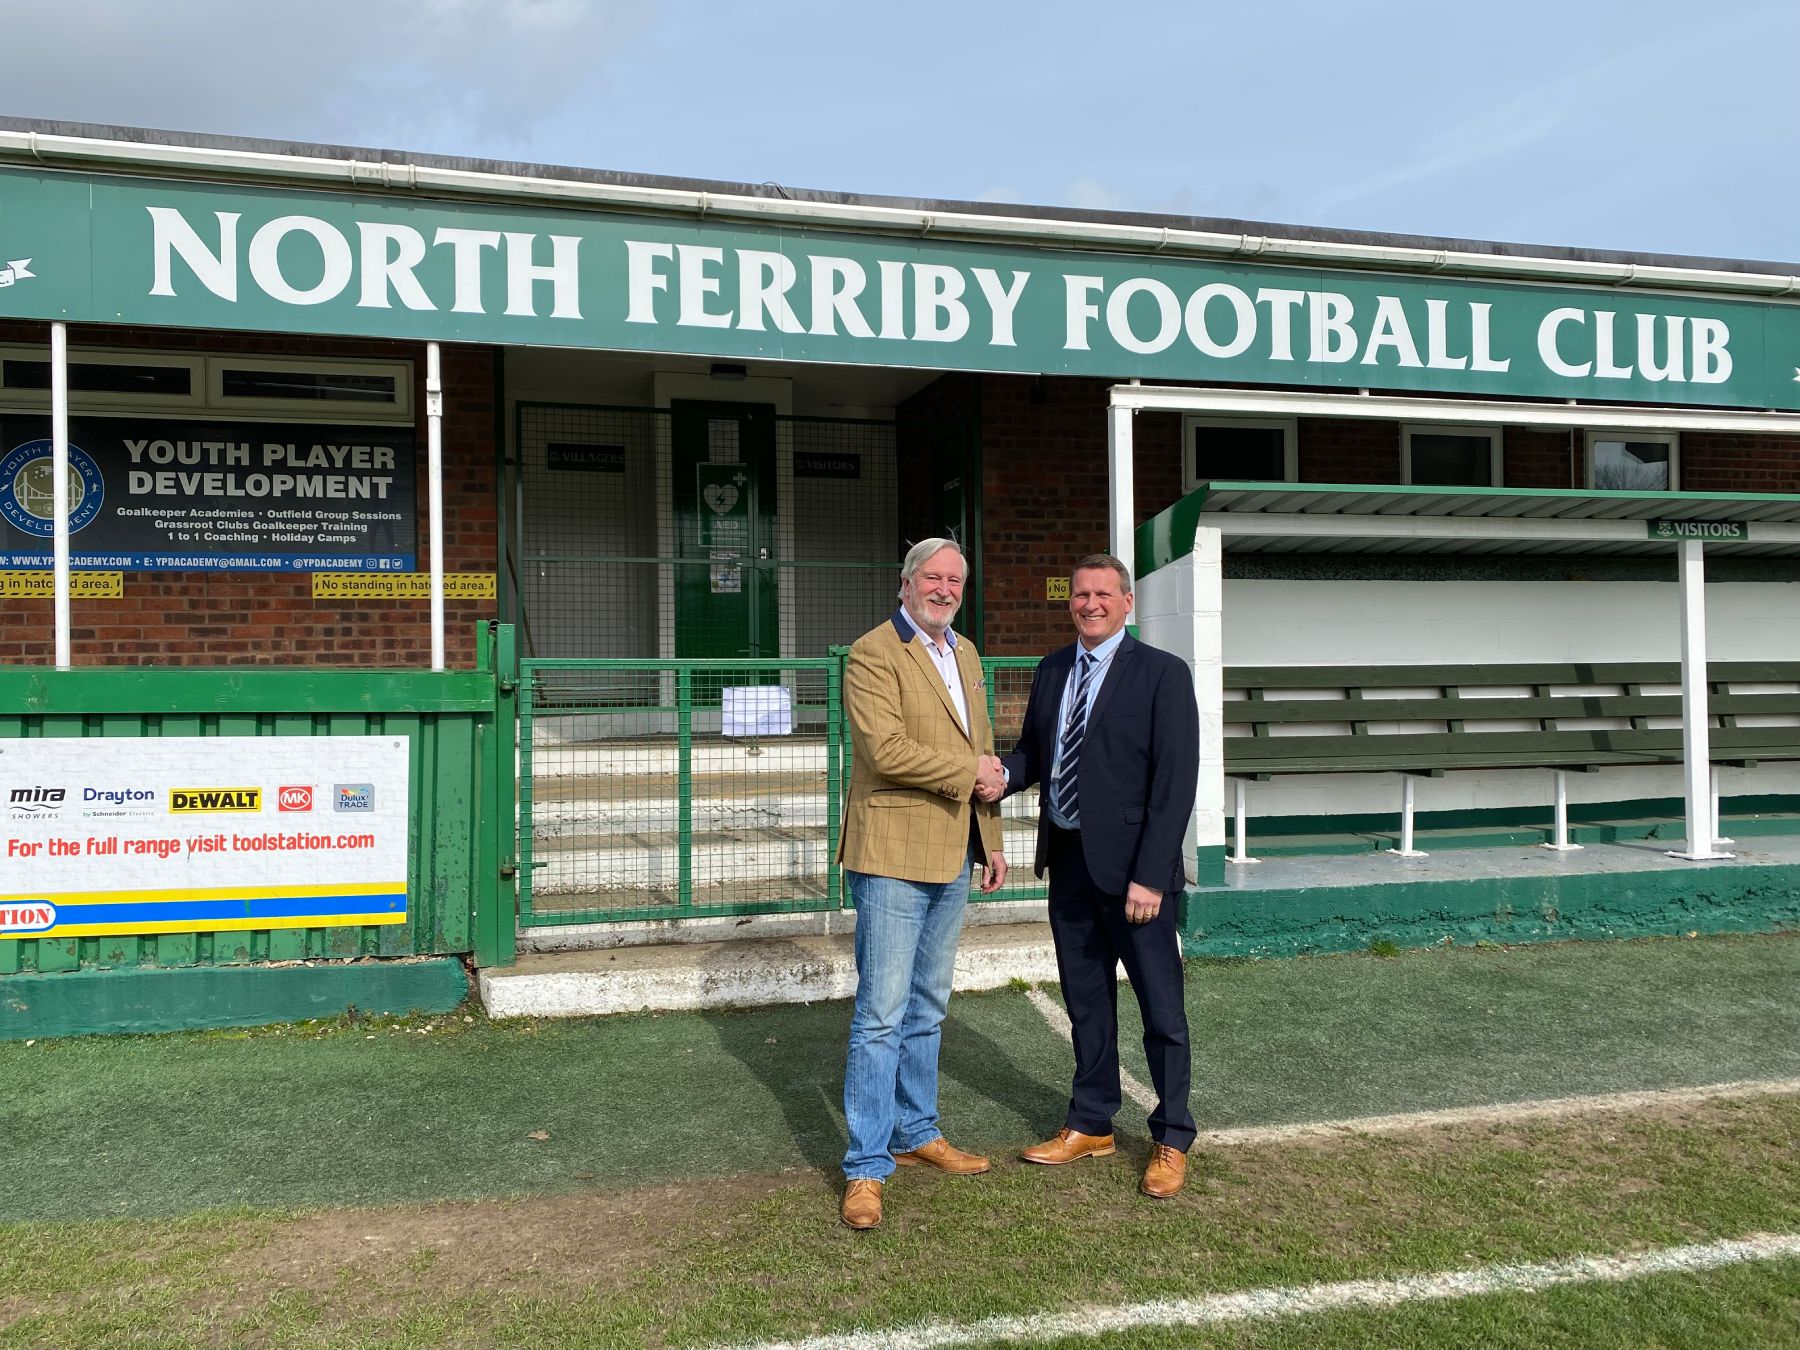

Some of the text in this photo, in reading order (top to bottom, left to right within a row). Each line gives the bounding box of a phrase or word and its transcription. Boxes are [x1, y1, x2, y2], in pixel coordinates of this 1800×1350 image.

[145, 206, 1733, 384] NORTH FERRIBY FOOTBALL CLUB
[4, 446, 41, 476] YOUTH
[123, 440, 396, 470] YOUTH PLAYER
[562, 451, 625, 463] VILLAGERS
[807, 459, 855, 471] VISITORS
[128, 470, 393, 499] DEVELOPMENT
[116, 507, 402, 521] Goalkeeper Academies Outfield Group Sessions
[154, 520, 368, 533] Grassroot Clubs Goalkeeper Training
[1674, 522, 1741, 537] VISITORS
[168, 532, 357, 544] 1 to 1 Coaching Holiday Camps
[12, 556, 132, 566] WWW.YPCADEMY.COM
[143, 557, 153, 566] E:
[156, 557, 282, 568] YPDACADEMY@GMAIL.COM
[292, 558, 363, 568] @YPDACADEMY
[9, 578, 21, 589] in
[25, 578, 78, 589] hatcd
[81, 579, 113, 589] area.
[322, 580, 339, 590] No
[342, 580, 393, 592] standing
[397, 580, 407, 590] in
[460, 582, 488, 591] area.
[1054, 583, 1067, 593] No
[10, 786, 66, 803] mira
[83, 788, 155, 805] Drayton
[283, 791, 306, 805] MK
[341, 794, 366, 802] Dulux
[12, 812, 60, 820] SHOWERS
[8, 832, 375, 859] For the full range visit toolstation.com
